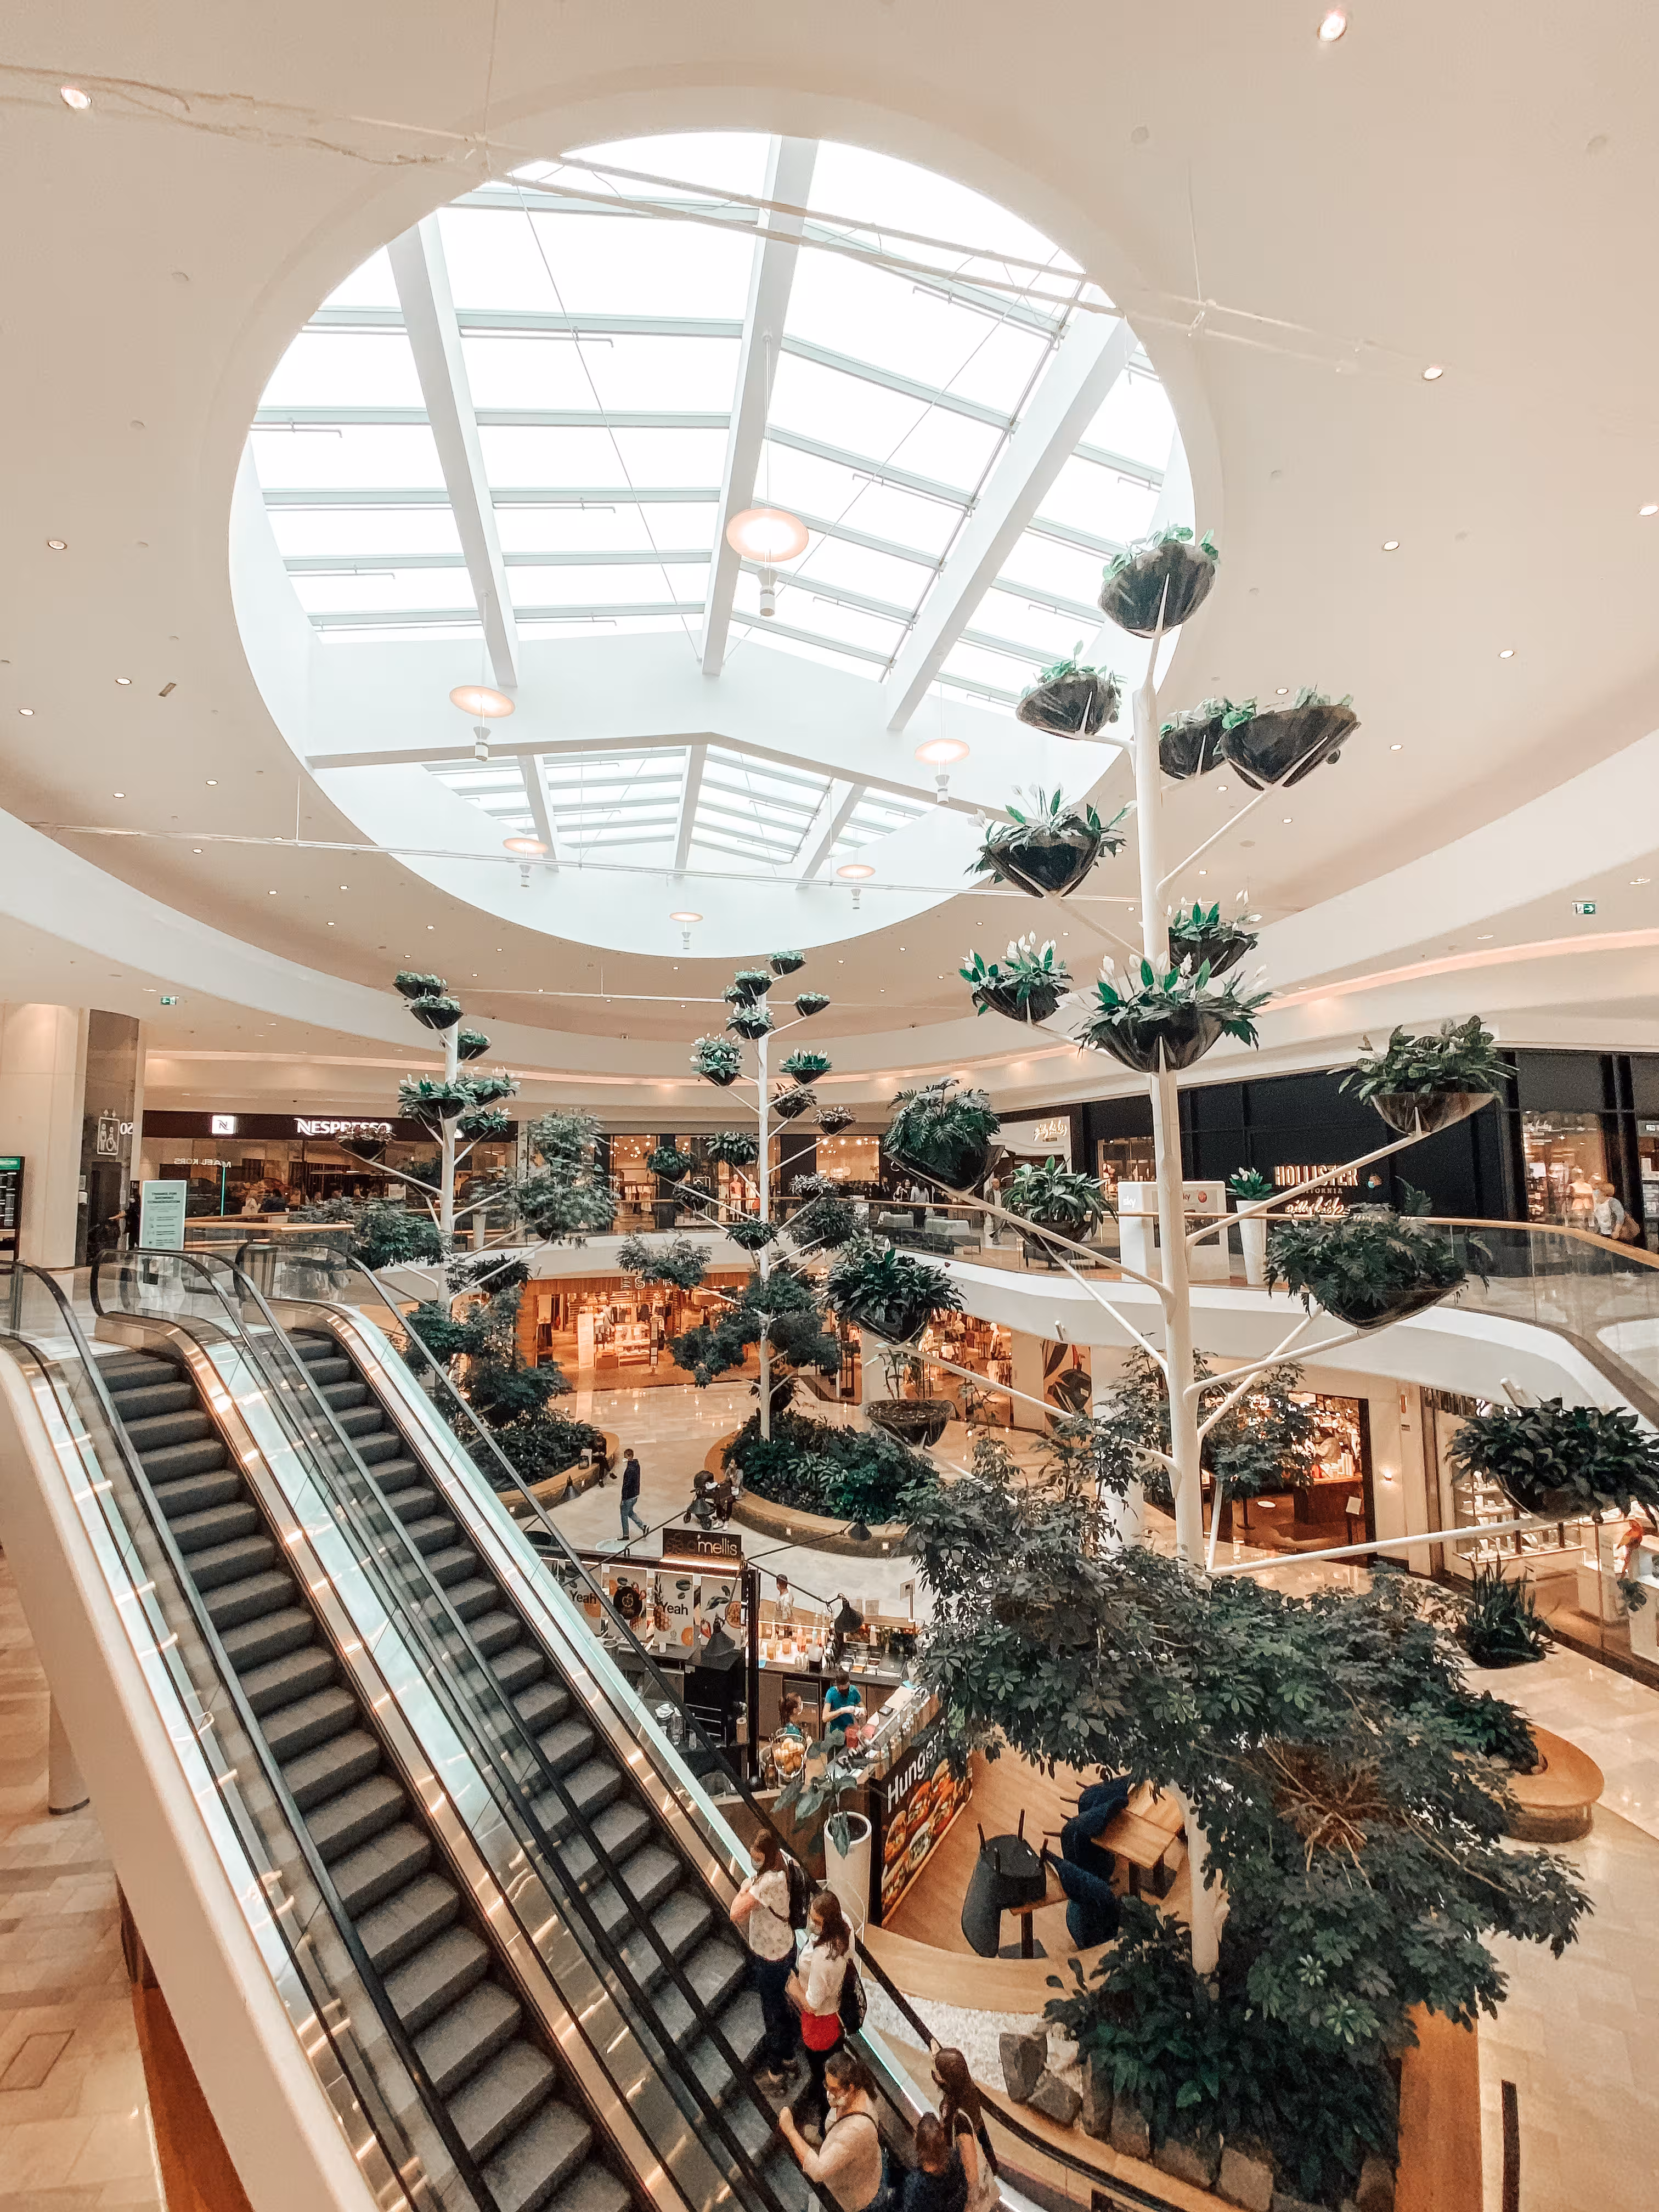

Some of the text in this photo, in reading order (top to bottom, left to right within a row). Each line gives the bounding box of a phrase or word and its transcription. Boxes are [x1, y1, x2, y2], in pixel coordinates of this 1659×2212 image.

[1274, 1165, 1358, 1186] HOLLISTER
[1123, 1196, 1136, 1207] sky
[621, 1277, 674, 1290] ESPR
[698, 1536, 737, 1556] mellis
[569, 1590, 597, 1604] Yeah
[661, 1601, 689, 1616] Yeah
